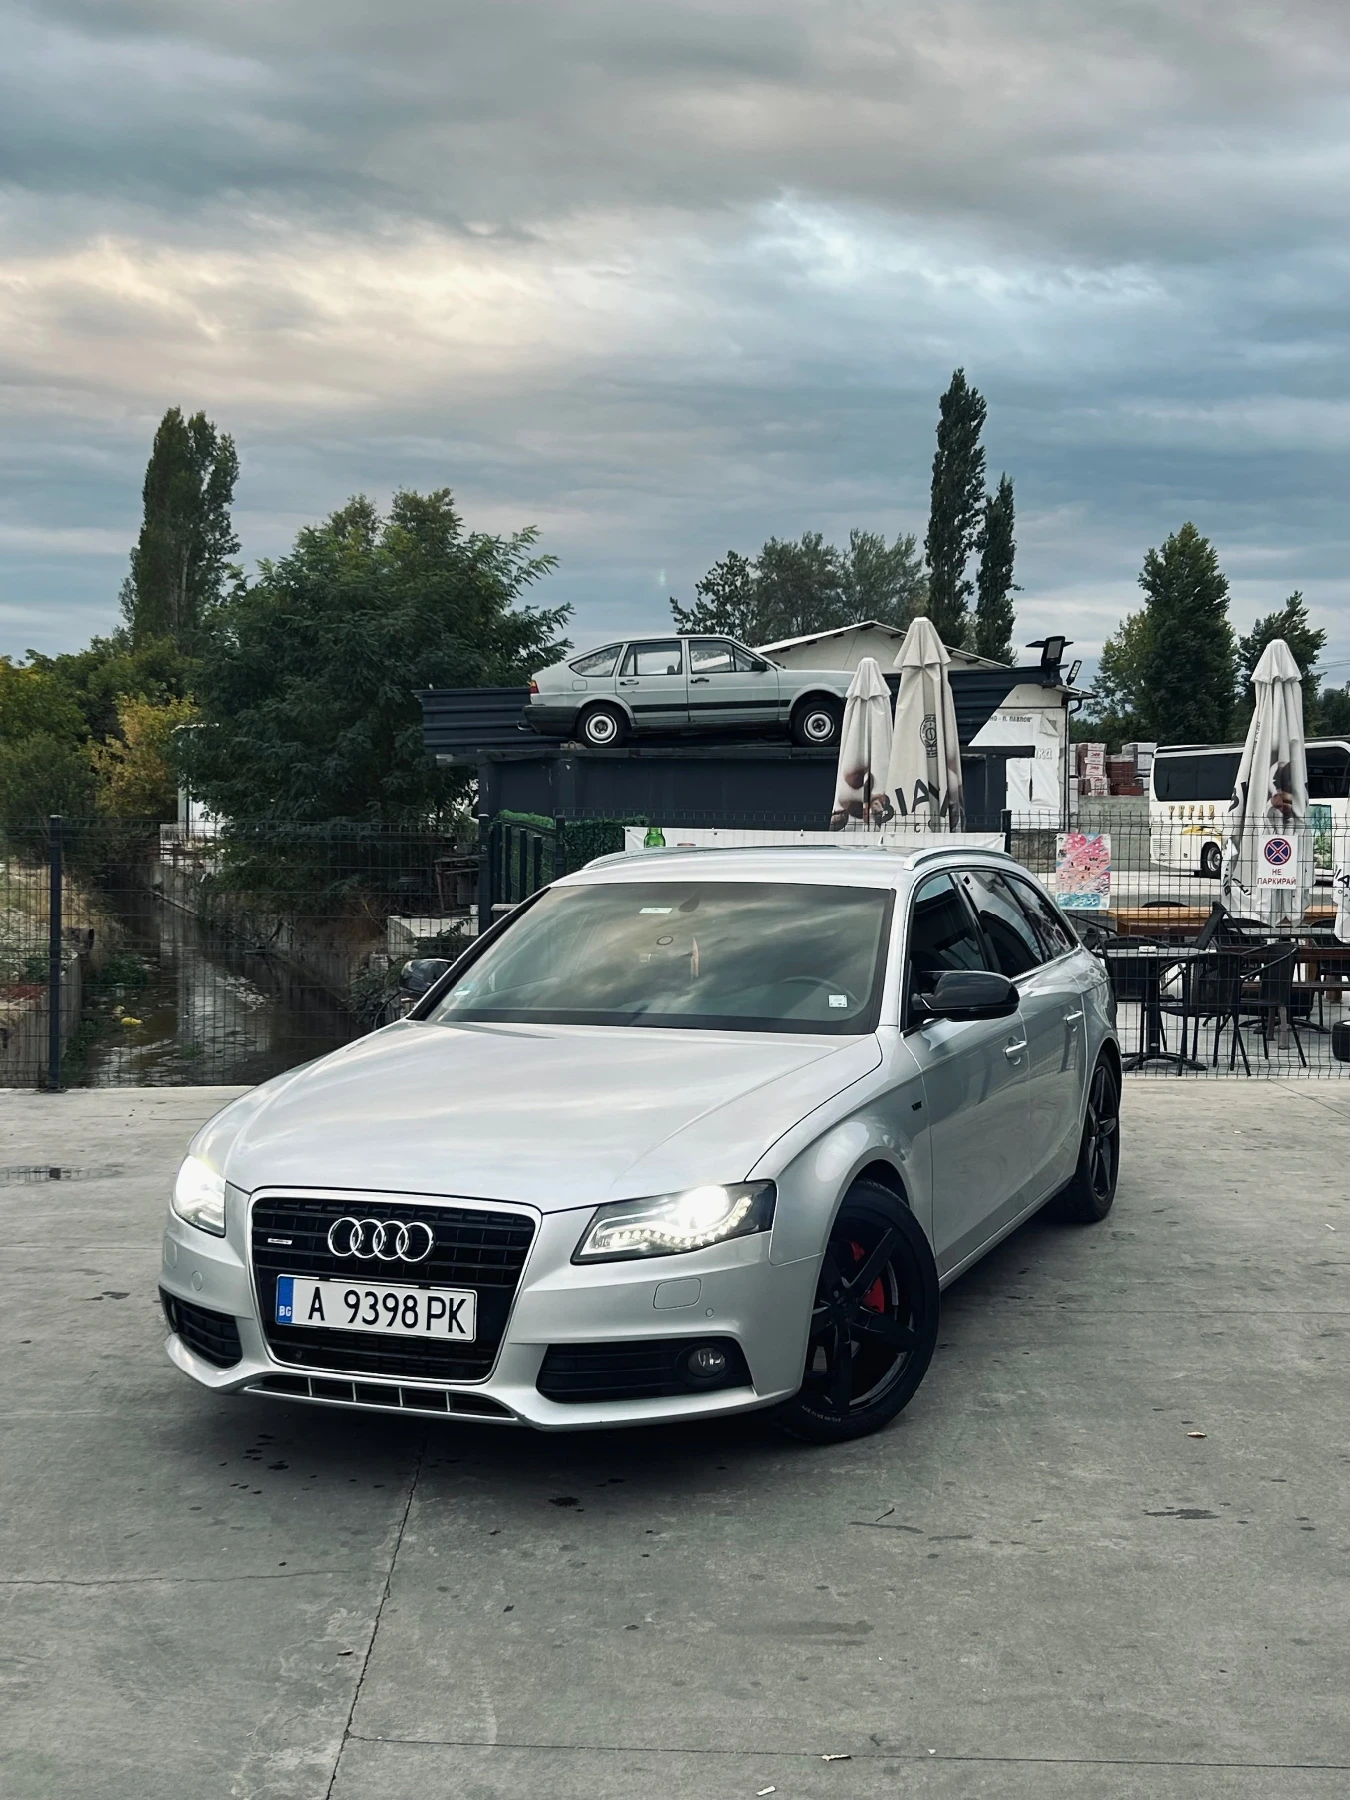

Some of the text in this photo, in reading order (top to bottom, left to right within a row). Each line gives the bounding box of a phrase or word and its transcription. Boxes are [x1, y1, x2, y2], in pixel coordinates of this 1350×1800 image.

[1271, 868, 1282, 876] НЕ
[1256, 877, 1297, 885] ПАРКИРАЙ
[307, 1286, 325, 1321] A
[279, 1305, 292, 1317] BG
